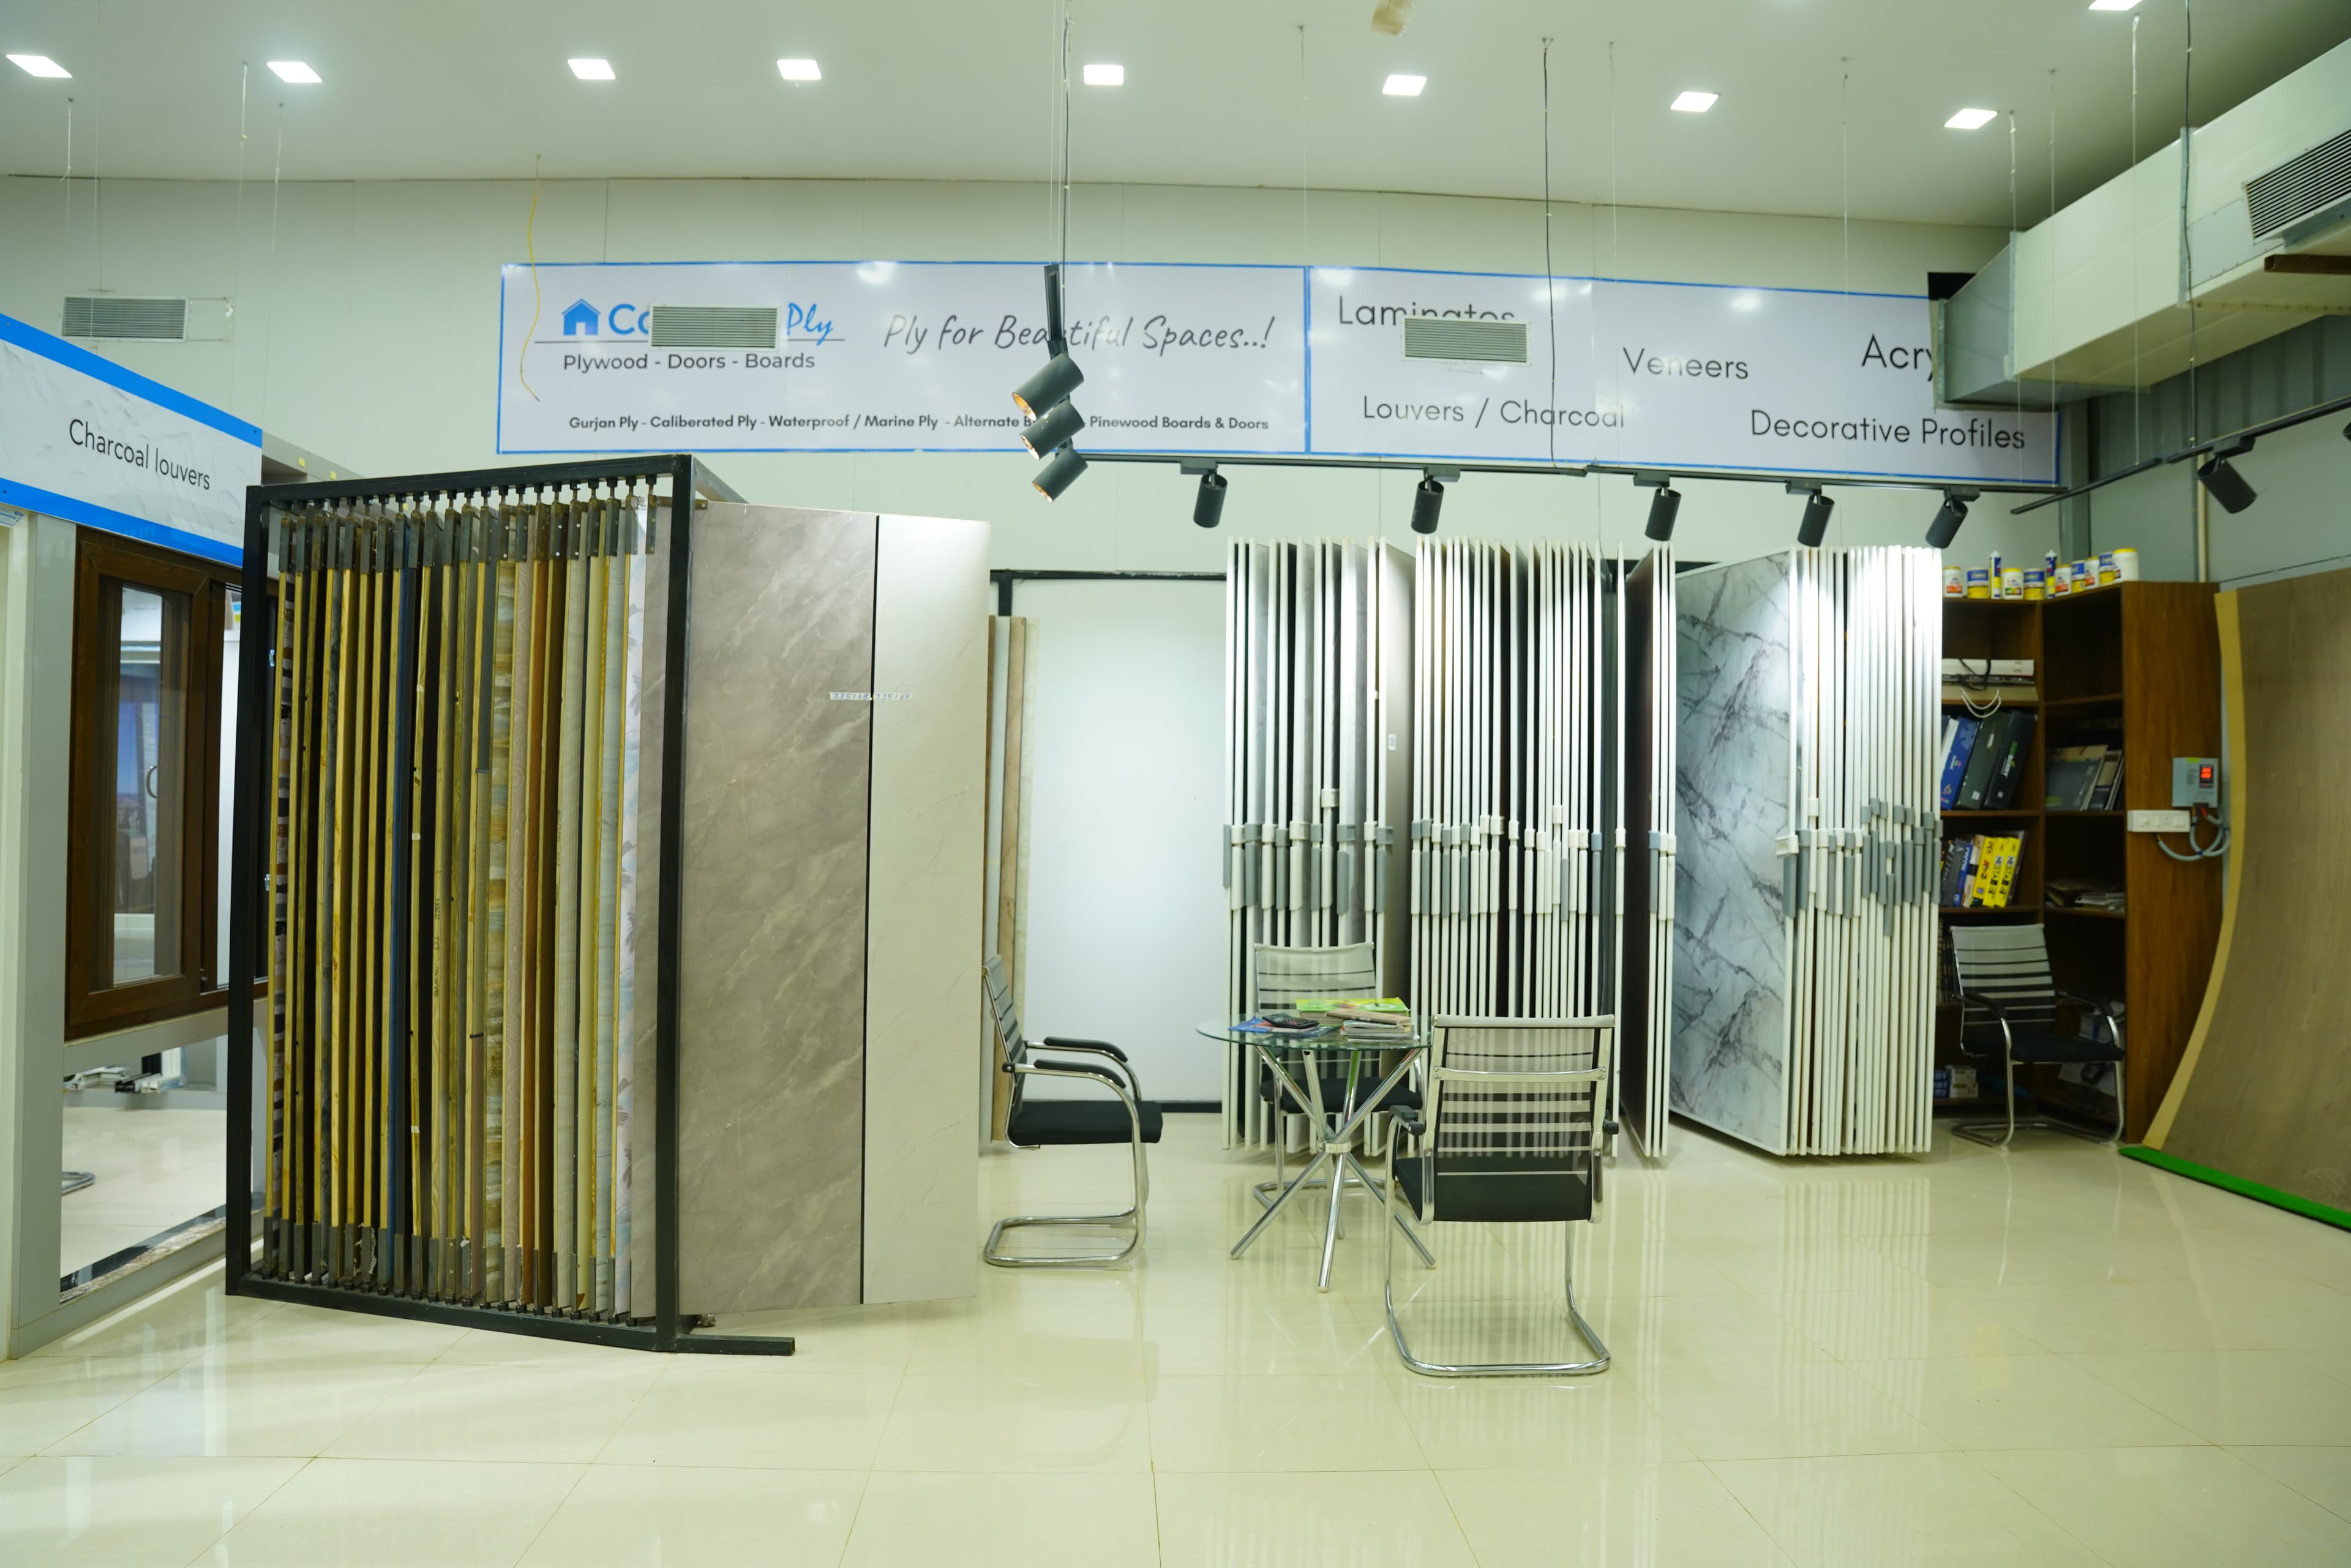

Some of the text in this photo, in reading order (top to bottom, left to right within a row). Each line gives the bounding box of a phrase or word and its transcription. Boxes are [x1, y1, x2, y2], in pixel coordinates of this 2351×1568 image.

[787, 302, 834, 347] Ply
[884, 315, 929, 355] Ply
[939, 315, 984, 351] for
[994, 315, 1134, 352] Beatiful
[564, 353, 648, 375] Plywood
[669, 354, 727, 370] Doors
[746, 353, 816, 370] Boards
[1623, 347, 1749, 381] Veneers
[569, 417, 617, 433] Gurjan
[620, 415, 640, 433] Ply
[650, 415, 735, 429] Caliberated
[738, 415, 758, 432] Ply
[769, 415, 851, 432] Waterproof
[864, 415, 916, 428] Marine
[919, 415, 939, 432] Ply
[954, 414, 1021, 428] Alternate
[1090, 415, 1159, 429] Pinewood
[1162, 416, 1212, 430] Boards
[1215, 417, 1226, 430] &
[1229, 417, 1270, 430] Doors
[1364, 396, 1465, 423] Louvers
[1501, 399, 1625, 428] Charcoal
[1752, 410, 2026, 450] Decorative Profiles
[69, 418, 211, 491] Charcoal louvers
